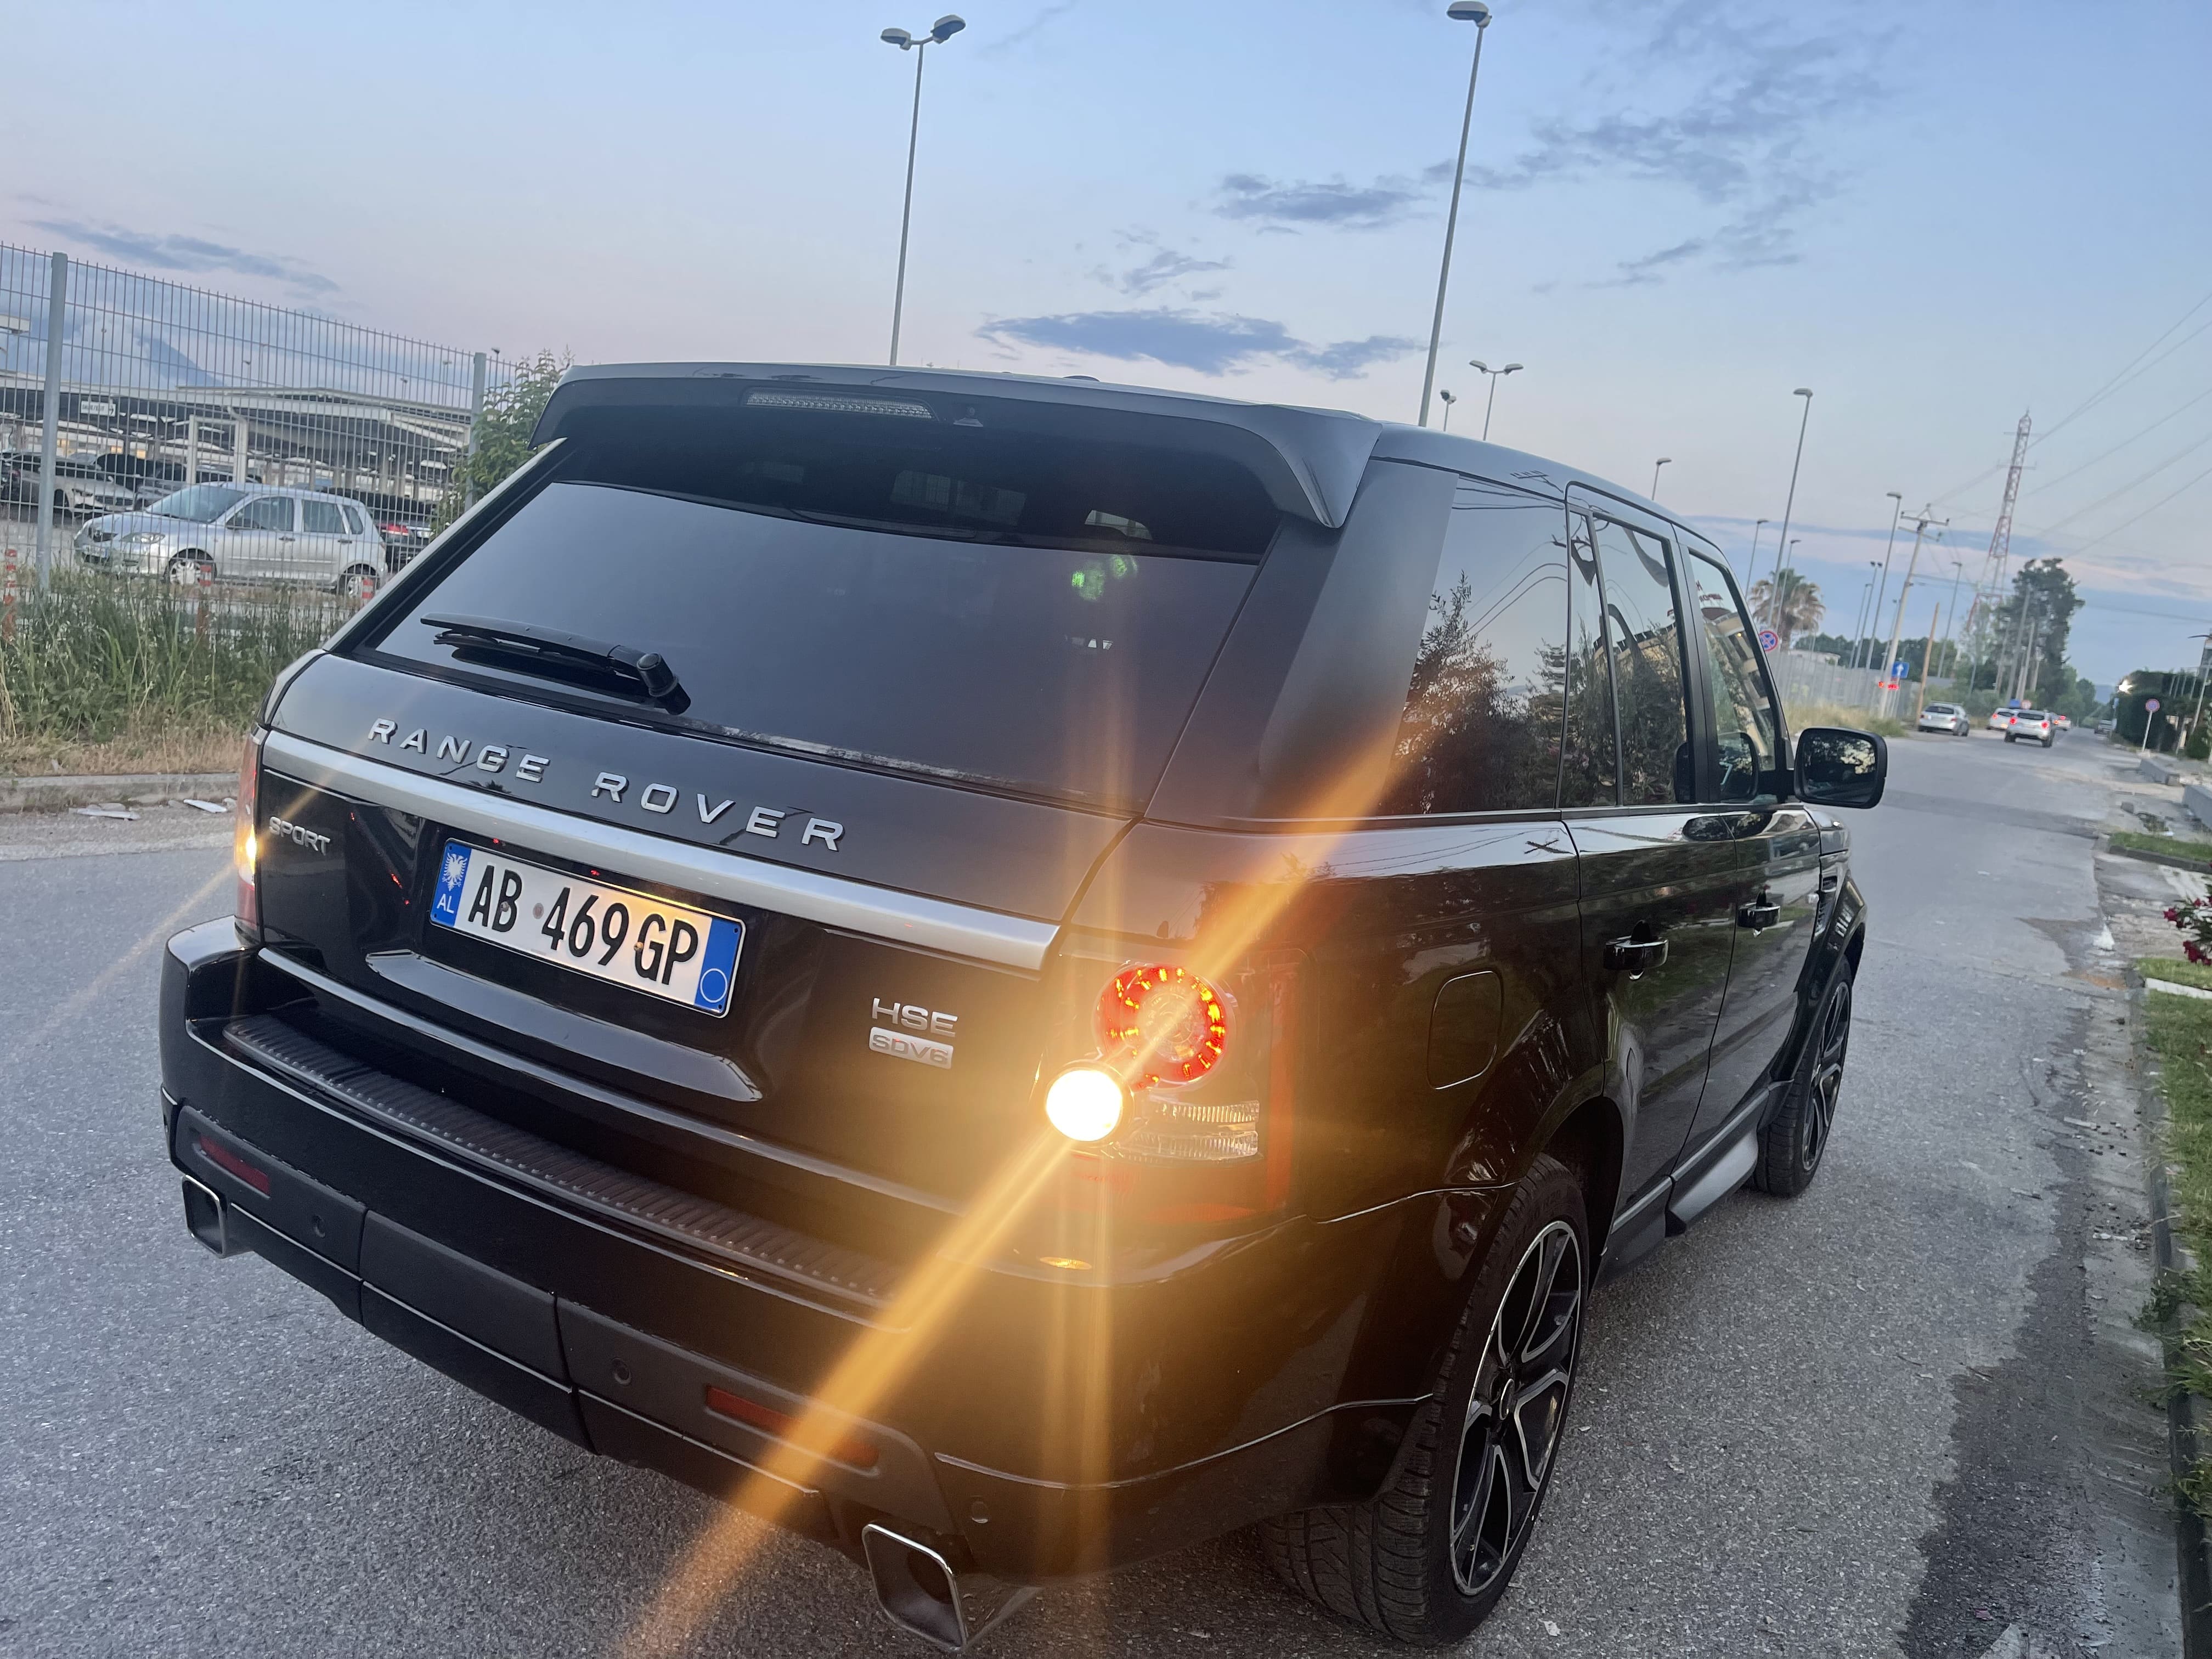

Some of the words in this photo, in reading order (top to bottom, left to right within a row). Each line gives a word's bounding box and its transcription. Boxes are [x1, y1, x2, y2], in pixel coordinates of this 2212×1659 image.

[368, 718, 550, 783] RANGE
[591, 772, 845, 851] ROVER
[269, 816, 331, 856] SPORT
[437, 893, 455, 914] AL
[468, 865, 522, 933] AB
[872, 997, 958, 1037] HSE
[872, 1034, 949, 1064] SDV6
